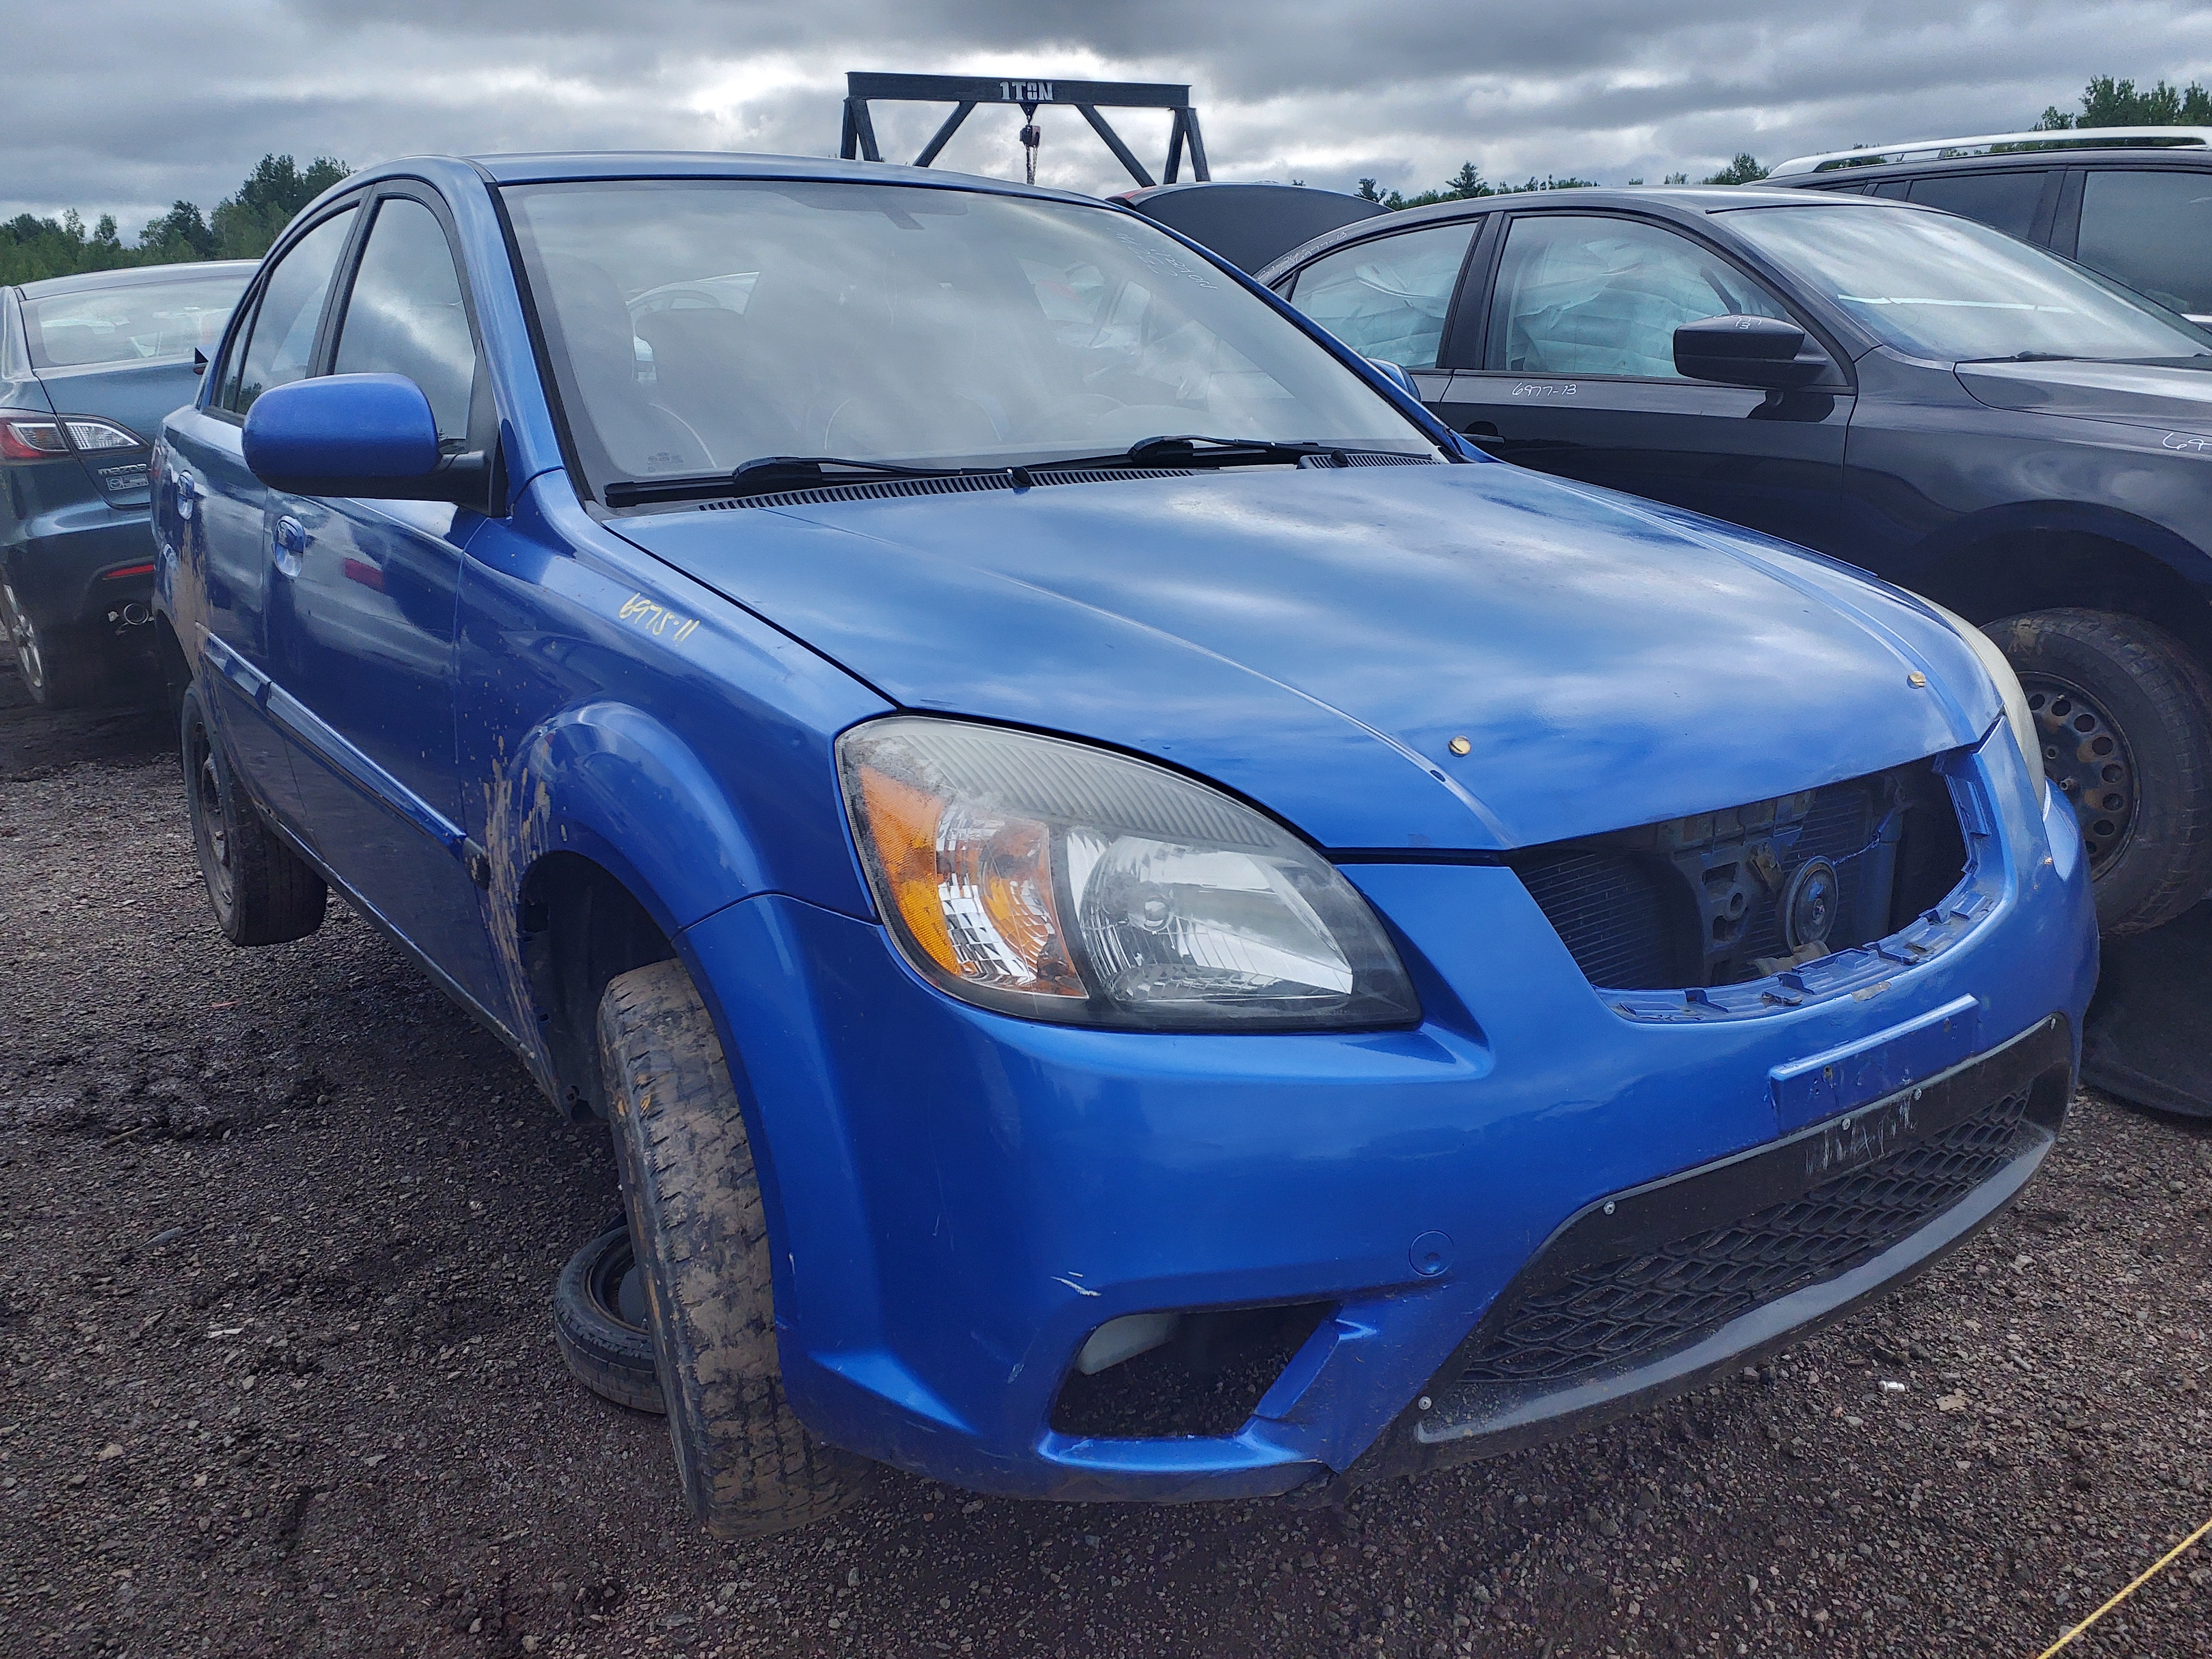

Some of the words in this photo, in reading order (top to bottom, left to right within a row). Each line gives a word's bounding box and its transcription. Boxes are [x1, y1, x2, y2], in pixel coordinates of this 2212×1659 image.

[1000, 81, 1011, 100] 1
[1012, 81, 1053, 100] TON
[1512, 382, 1577, 397] 6977-13
[2163, 432, 2212, 451] 69
